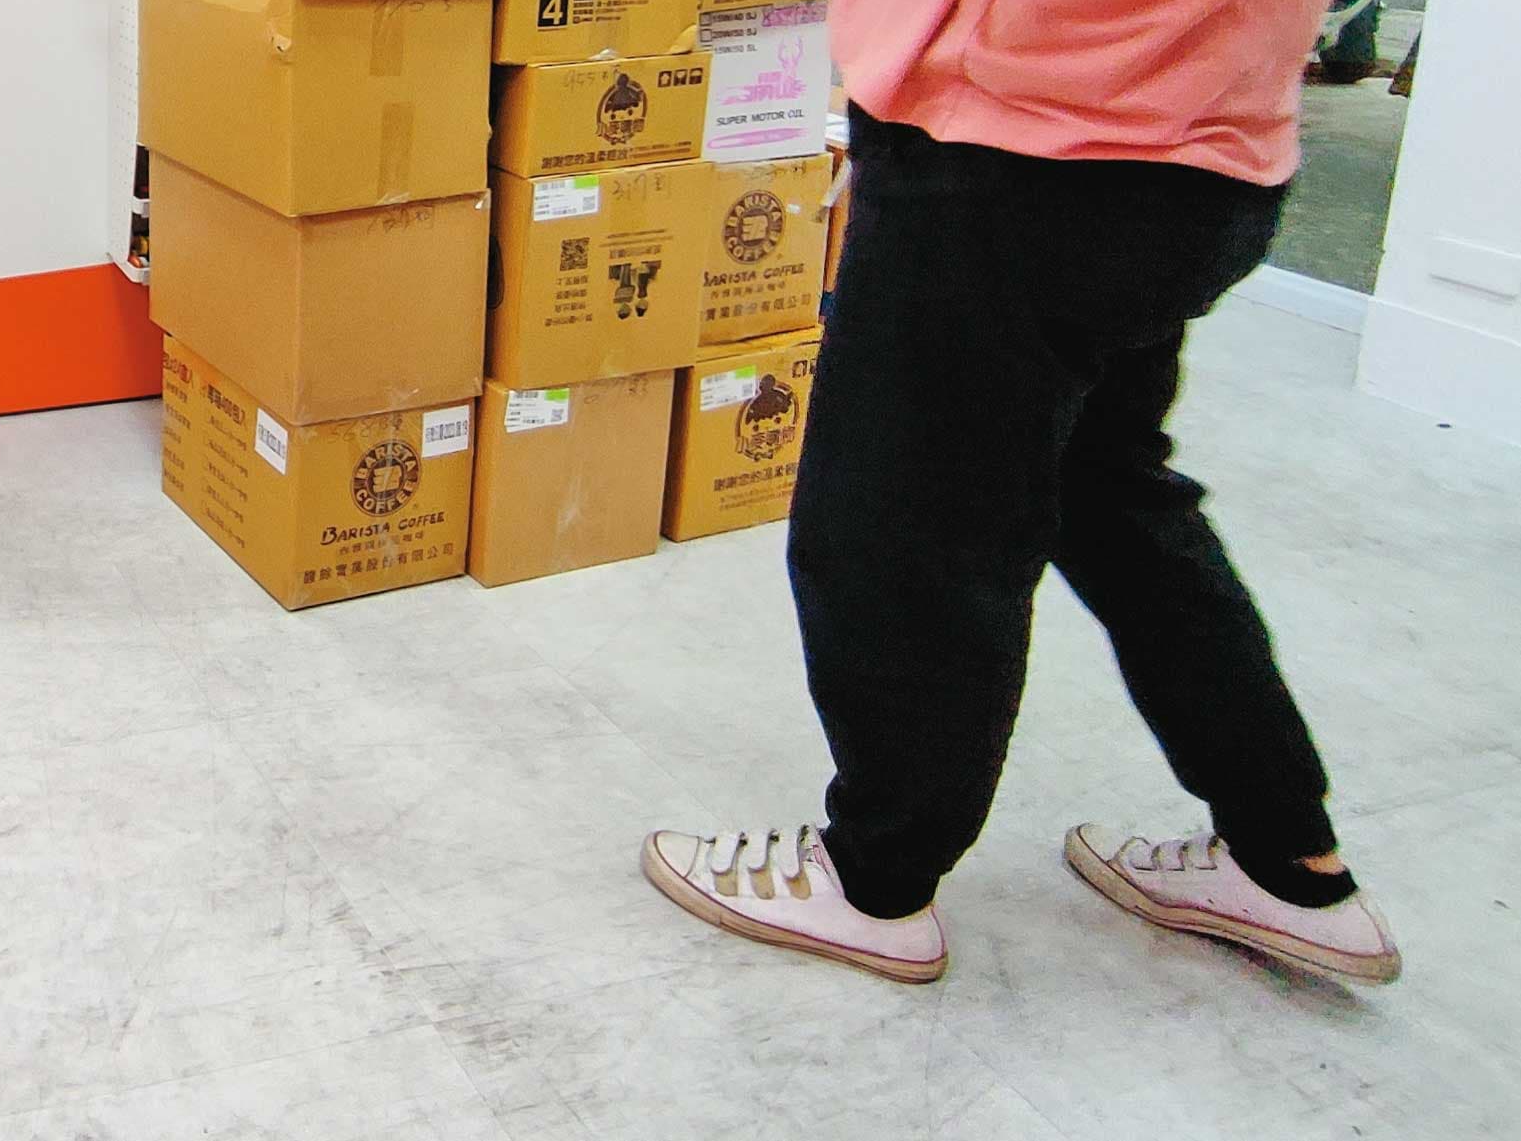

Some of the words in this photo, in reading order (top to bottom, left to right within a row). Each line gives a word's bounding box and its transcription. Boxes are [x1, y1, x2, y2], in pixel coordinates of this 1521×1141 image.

[716, 115, 748, 127] SUPER
[751, 111, 785, 122] MOTOR
[787, 109, 805, 119] OIL
[320, 521, 391, 546] BARISTA
[397, 511, 446, 531] COFFEE
